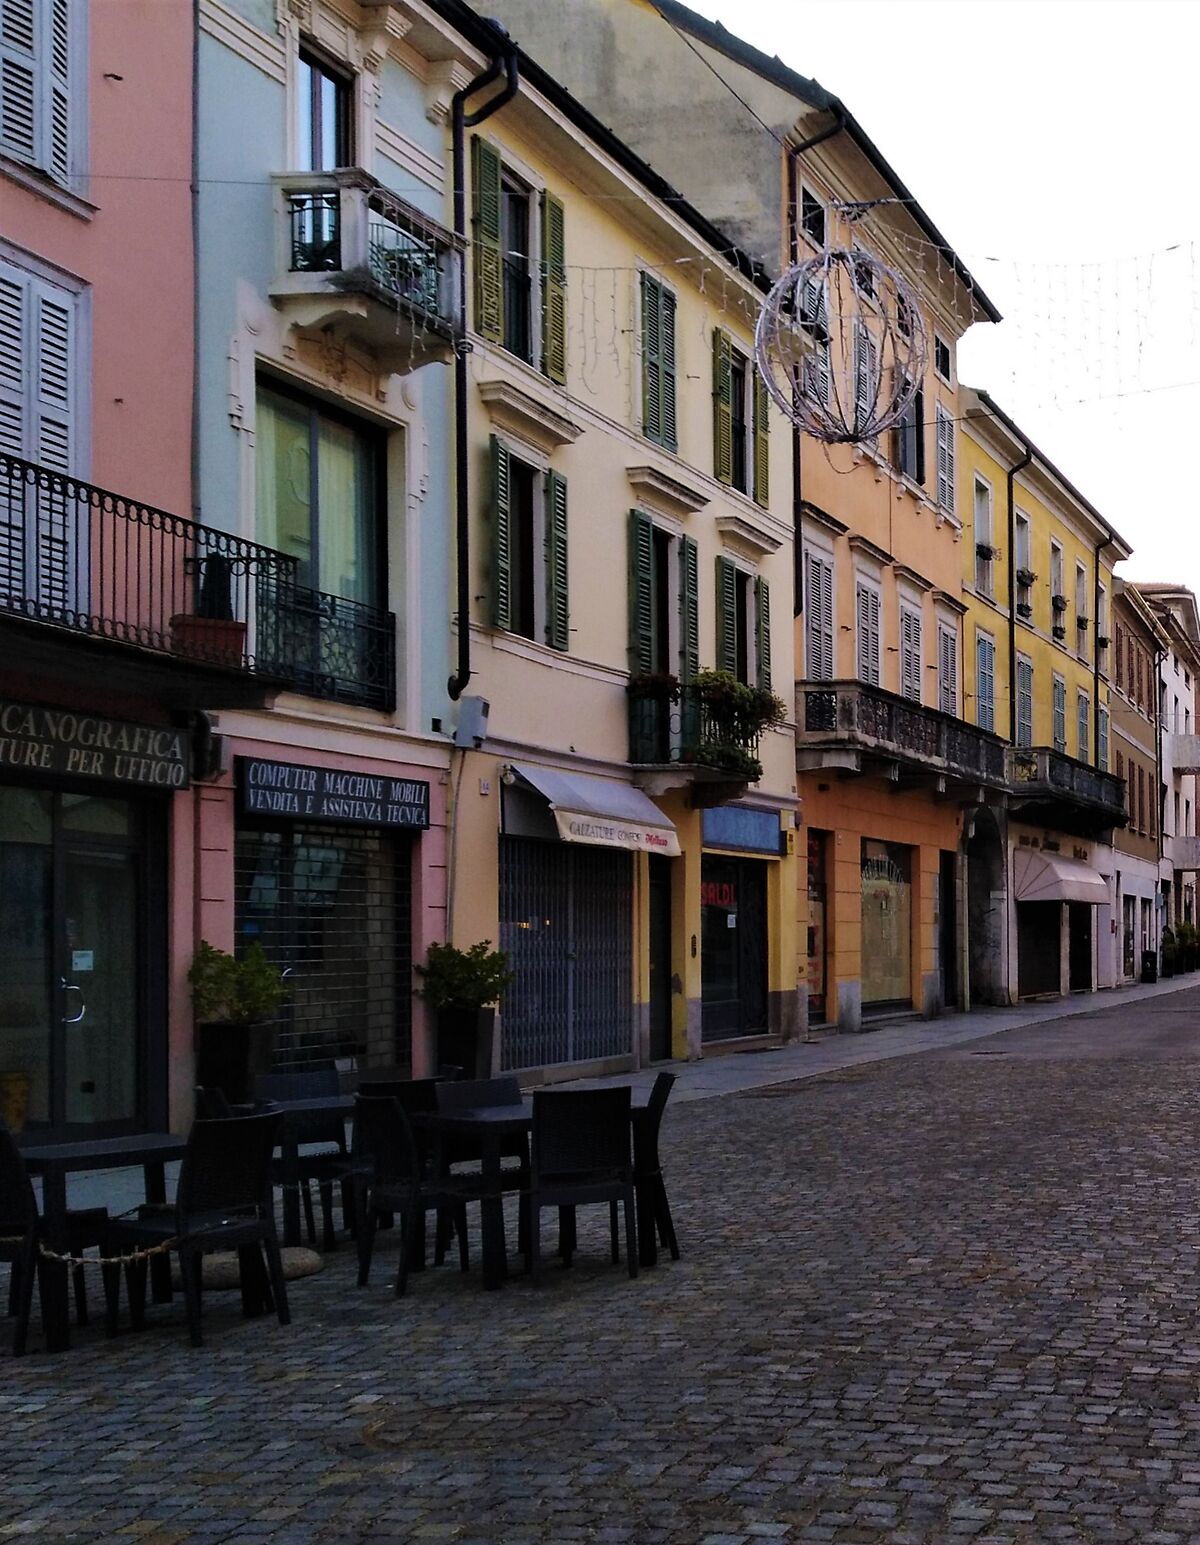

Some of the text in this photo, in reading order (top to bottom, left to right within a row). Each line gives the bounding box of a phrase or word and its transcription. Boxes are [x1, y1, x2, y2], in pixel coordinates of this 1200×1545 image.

[2, 704, 184, 760] CANOGRAFICA
[66, 748, 104, 775] PER
[114, 755, 184, 786] UFFICIO
[250, 762, 426, 804] COMPUTER MACCHINE MOBILI
[249, 789, 427, 825] VENDITA E ASSISTENZA TECNICA
